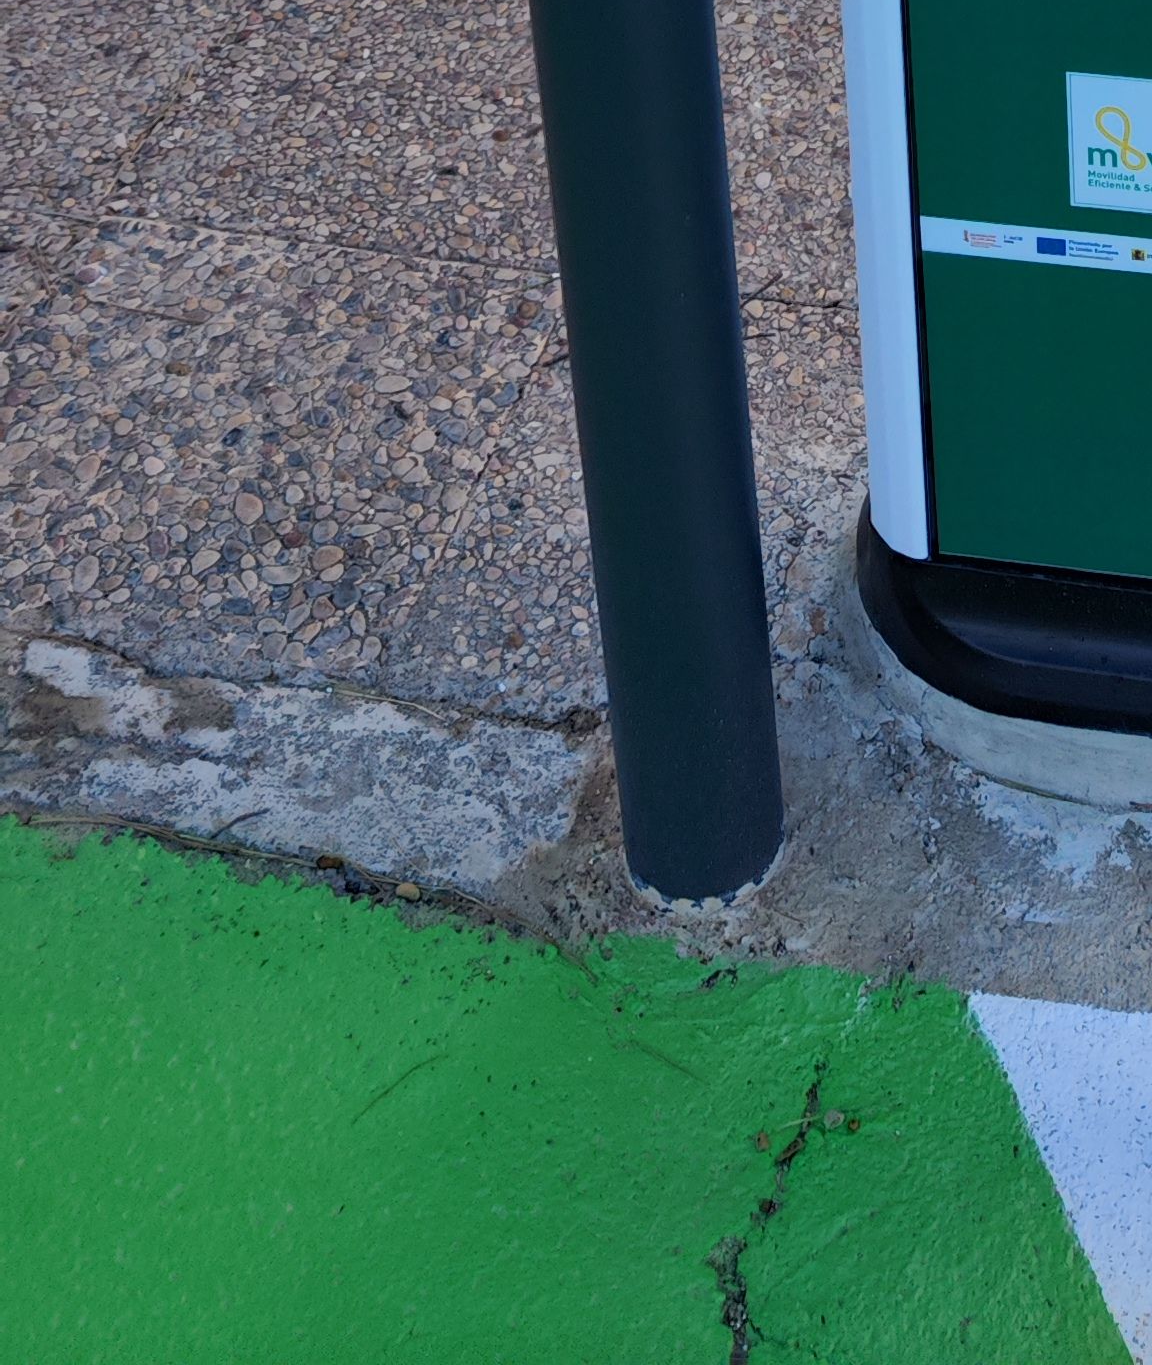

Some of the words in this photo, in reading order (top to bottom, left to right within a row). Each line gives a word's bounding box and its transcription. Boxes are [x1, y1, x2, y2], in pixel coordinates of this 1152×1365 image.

[1087, 169, 1136, 183] Movilidad
[1087, 178, 1131, 192] Eficiente
[1133, 182, 1142, 192] &
